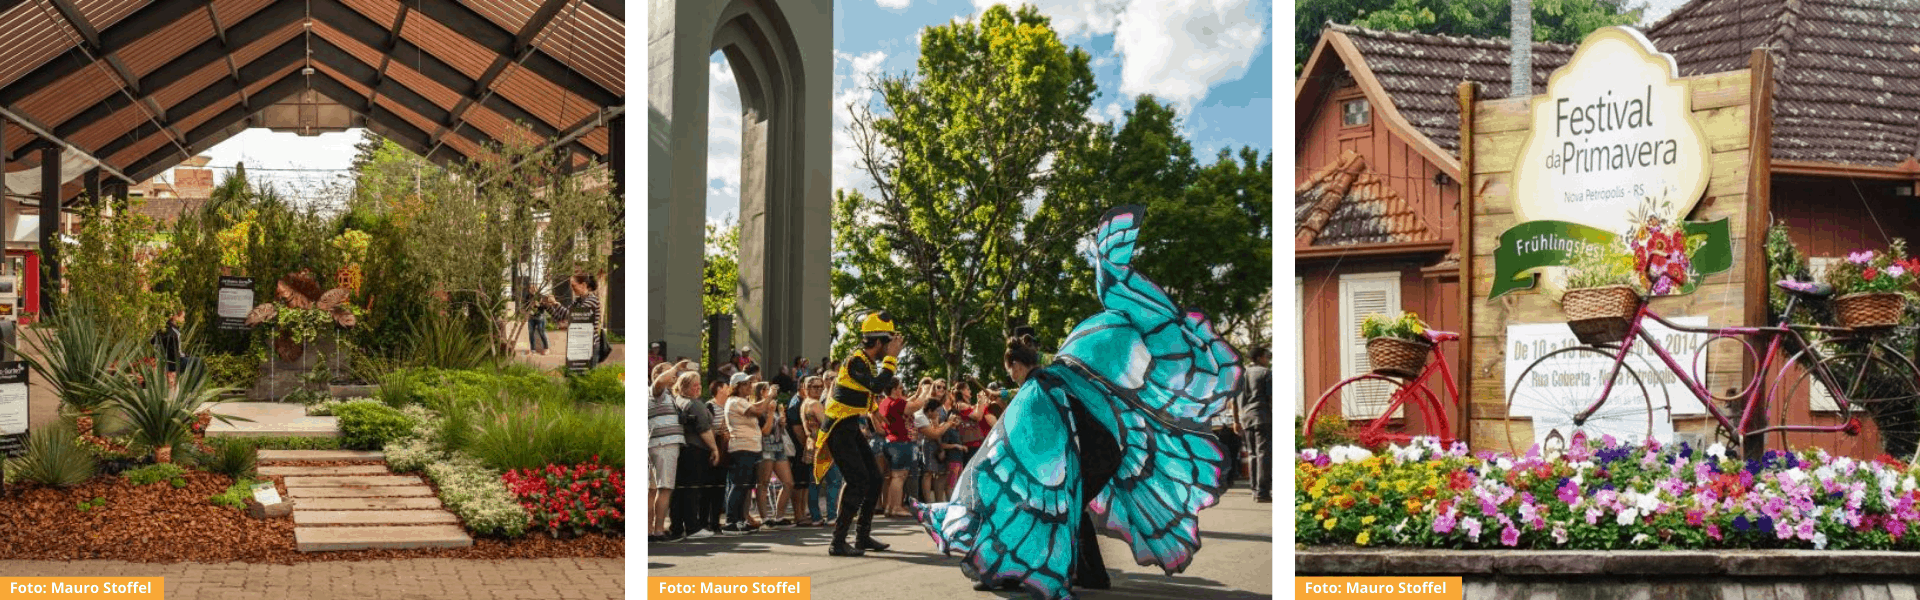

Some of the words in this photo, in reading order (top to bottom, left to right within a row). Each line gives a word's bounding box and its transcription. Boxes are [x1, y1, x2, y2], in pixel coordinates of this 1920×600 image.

[1556, 84, 1653, 137] Festival
[1545, 150, 1561, 169] da
[1562, 138, 1677, 175] Primavera
[1564, 191, 1584, 203] Nova
[1633, 183, 1645, 197] RS
[1514, 340, 1528, 360] De
[1532, 339, 1547, 360] 10
[1665, 333, 1698, 355] 2014
[1531, 370, 1549, 388] Rua
[1552, 369, 1591, 387] Coberta
[1599, 369, 1623, 386] Noa
